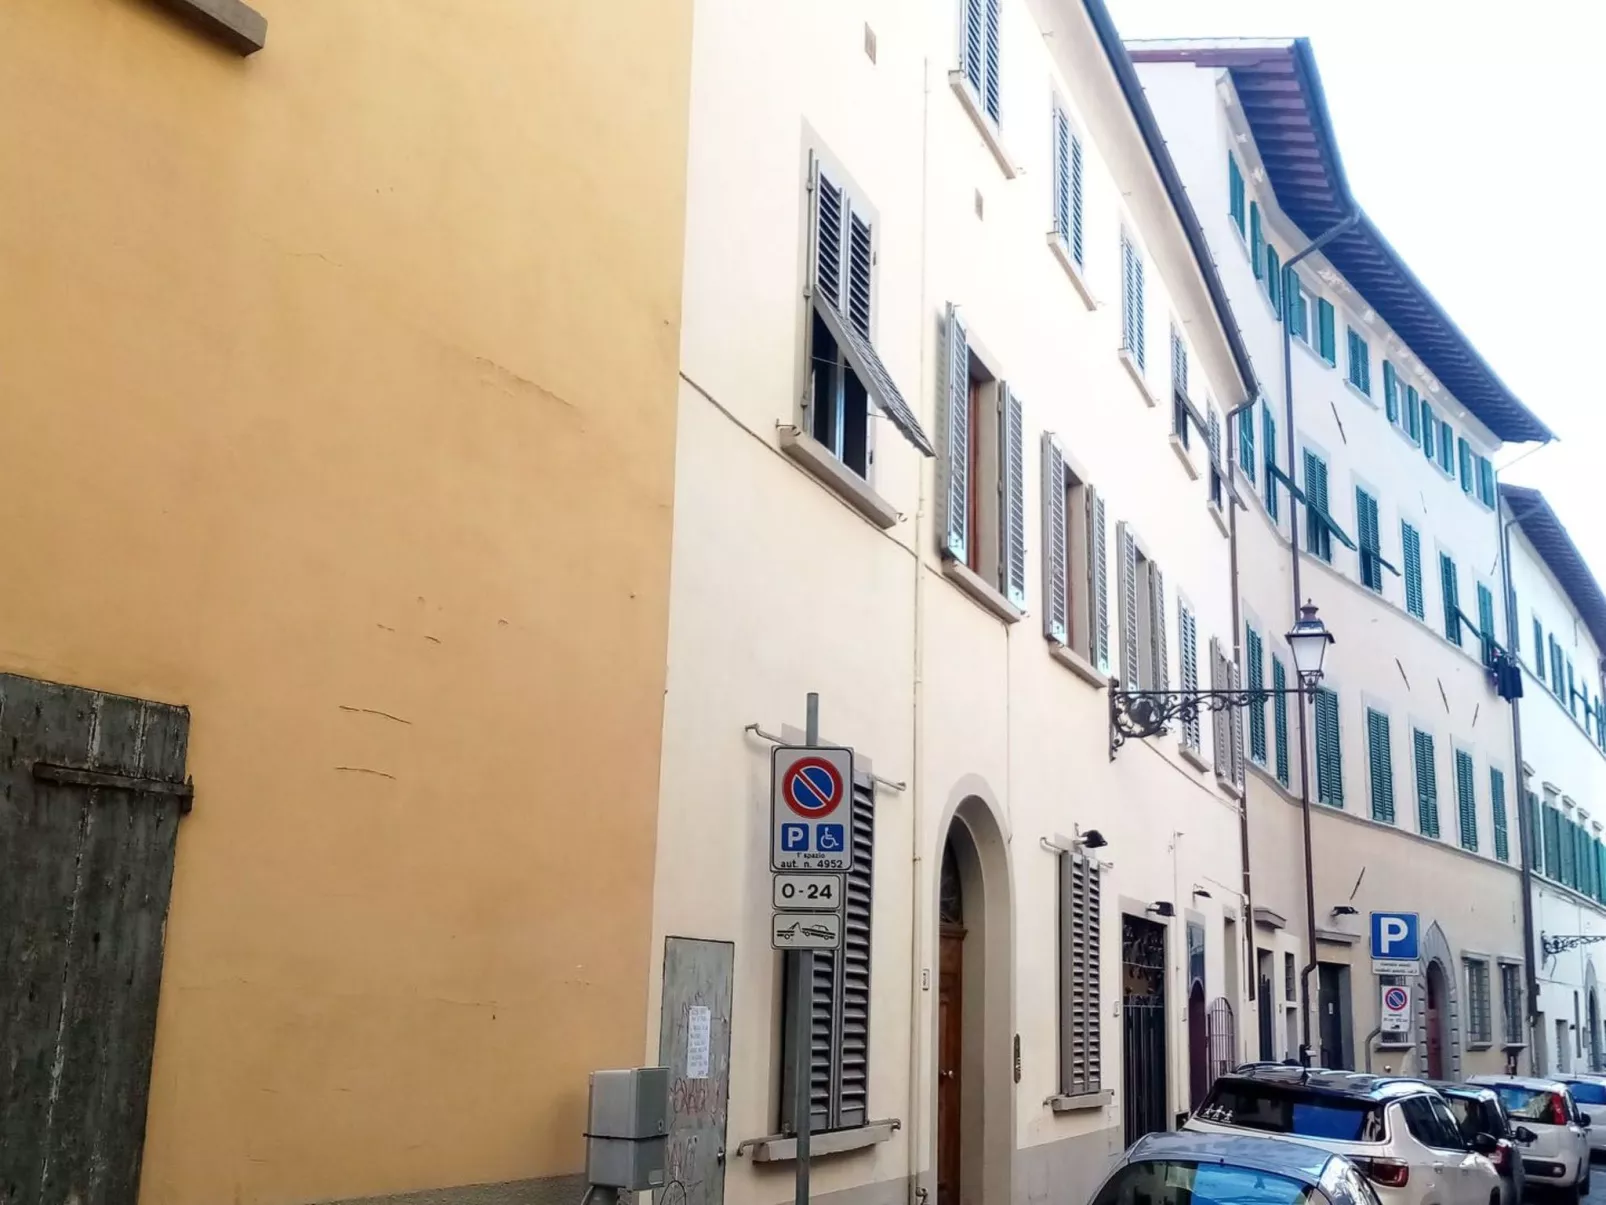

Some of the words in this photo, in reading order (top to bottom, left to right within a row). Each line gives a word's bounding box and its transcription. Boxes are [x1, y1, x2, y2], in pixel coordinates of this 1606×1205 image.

[788, 827, 804, 848] P
[780, 860, 799, 868] aut.
[817, 859, 843, 868] 4952
[1380, 916, 1409, 954] P
